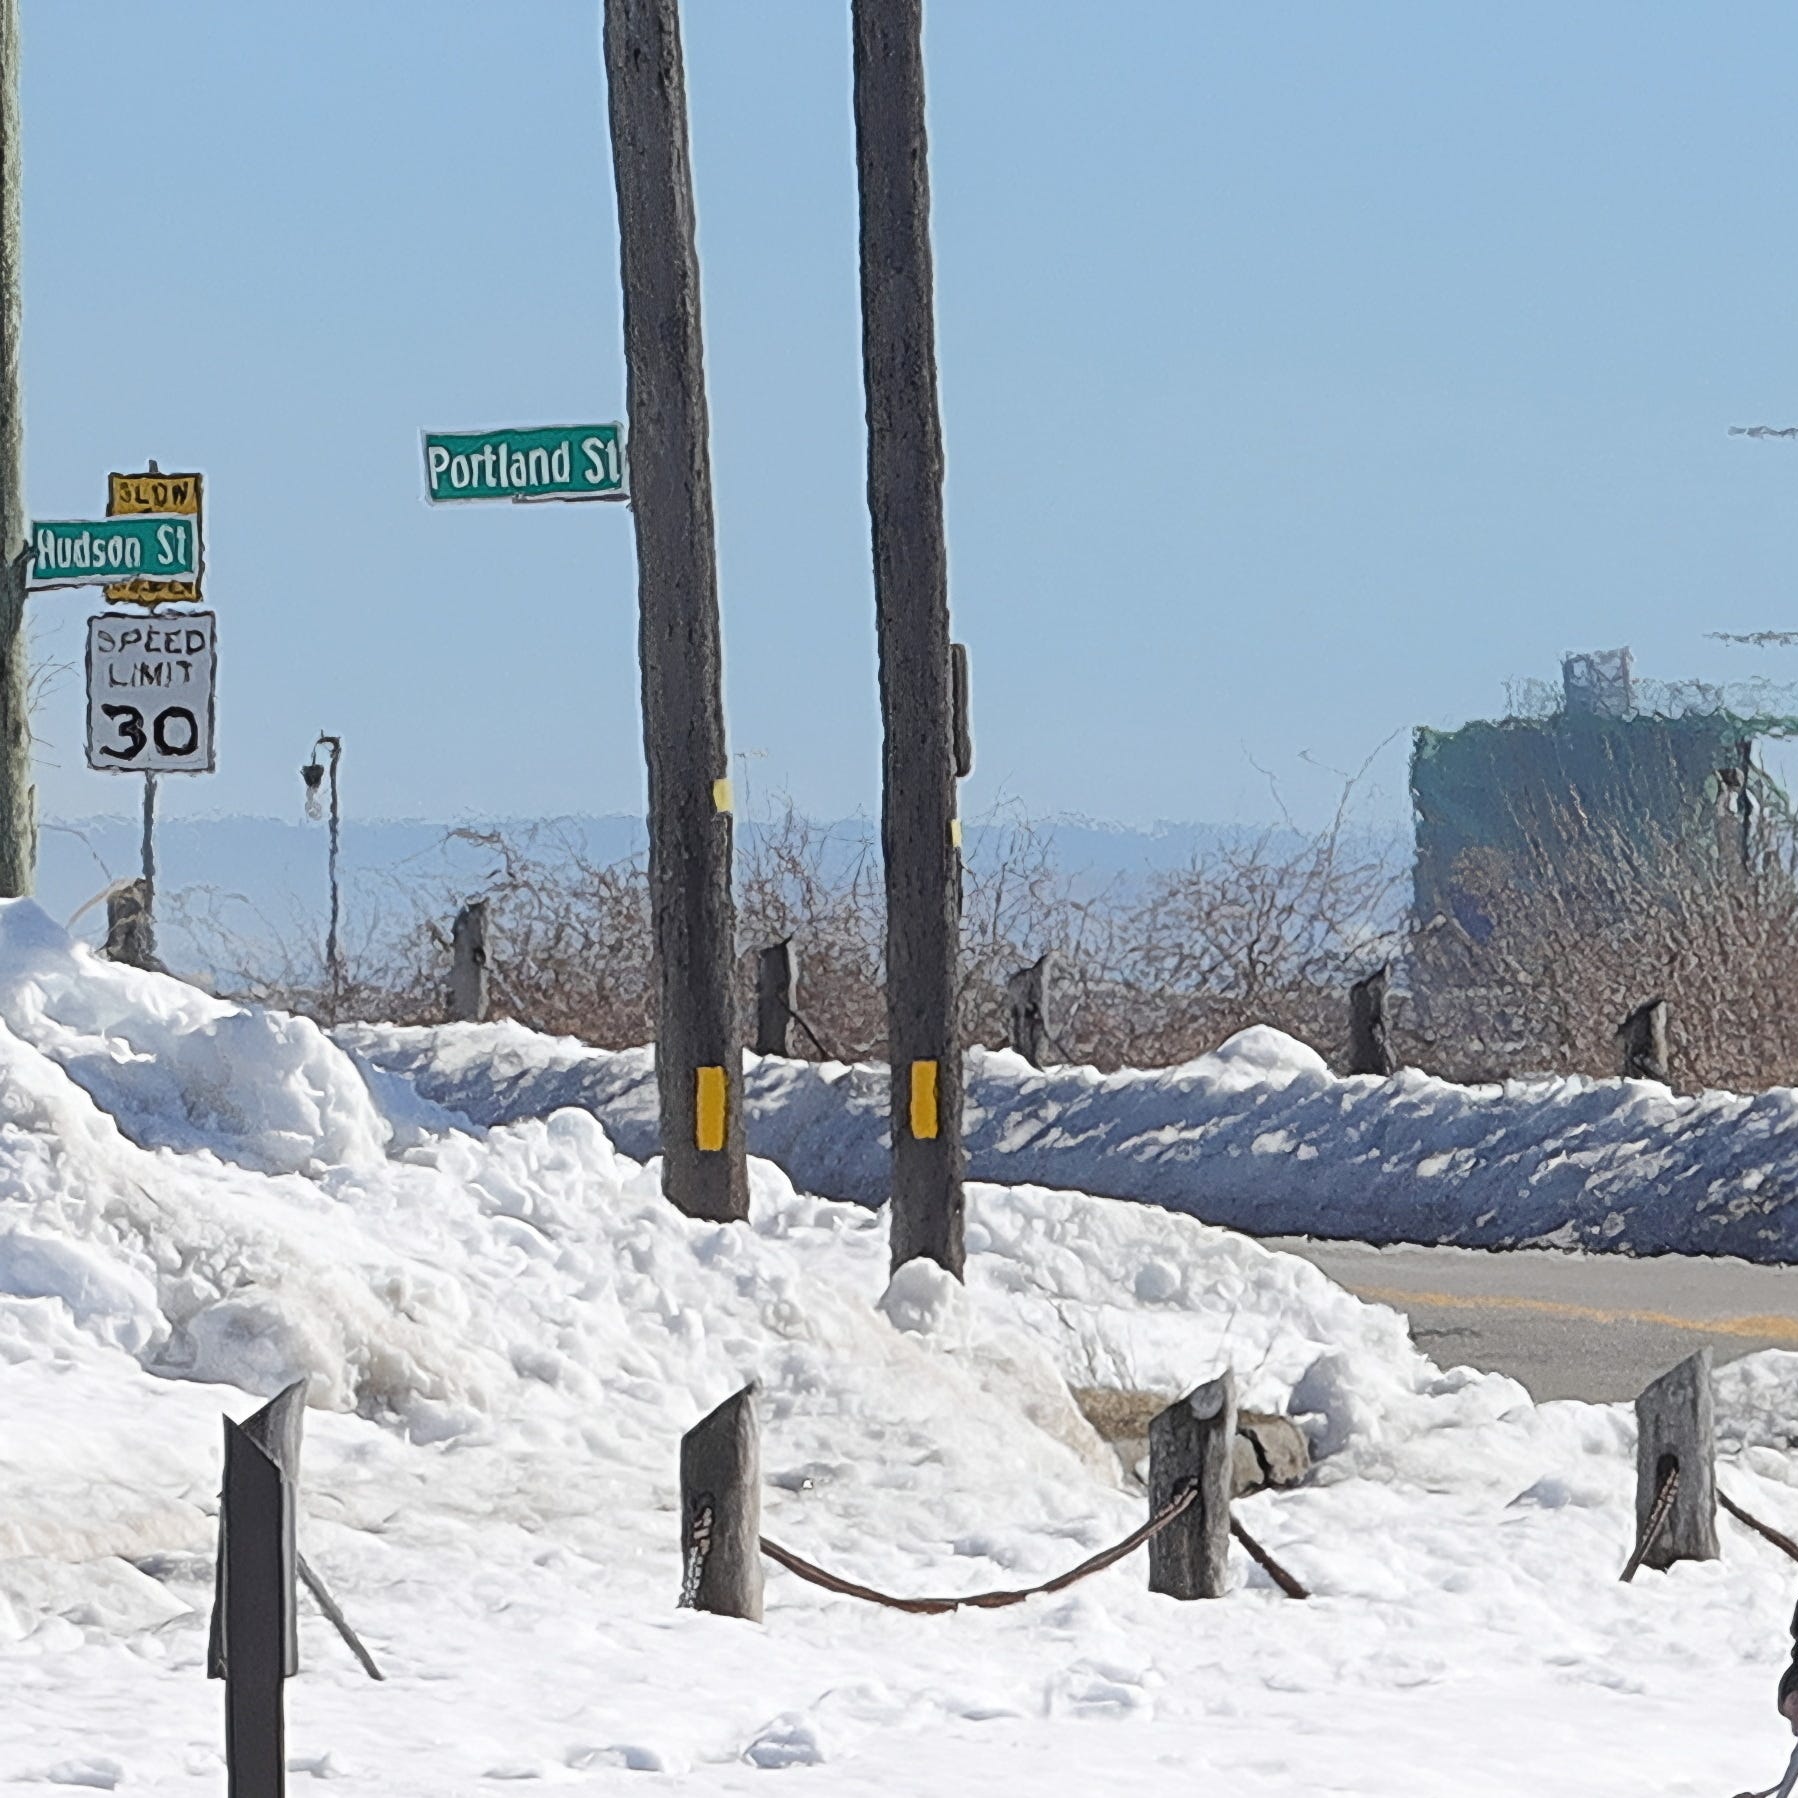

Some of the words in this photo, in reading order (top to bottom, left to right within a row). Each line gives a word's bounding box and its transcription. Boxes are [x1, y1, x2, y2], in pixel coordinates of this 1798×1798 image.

[427, 440, 571, 490] Portland
[581, 436, 621, 485] St
[37, 527, 142, 570] Hudson
[156, 523, 187, 566] St
[97, 625, 206, 655] SPEED
[108, 660, 193, 688] LIMIT
[99, 703, 199, 761] 30
